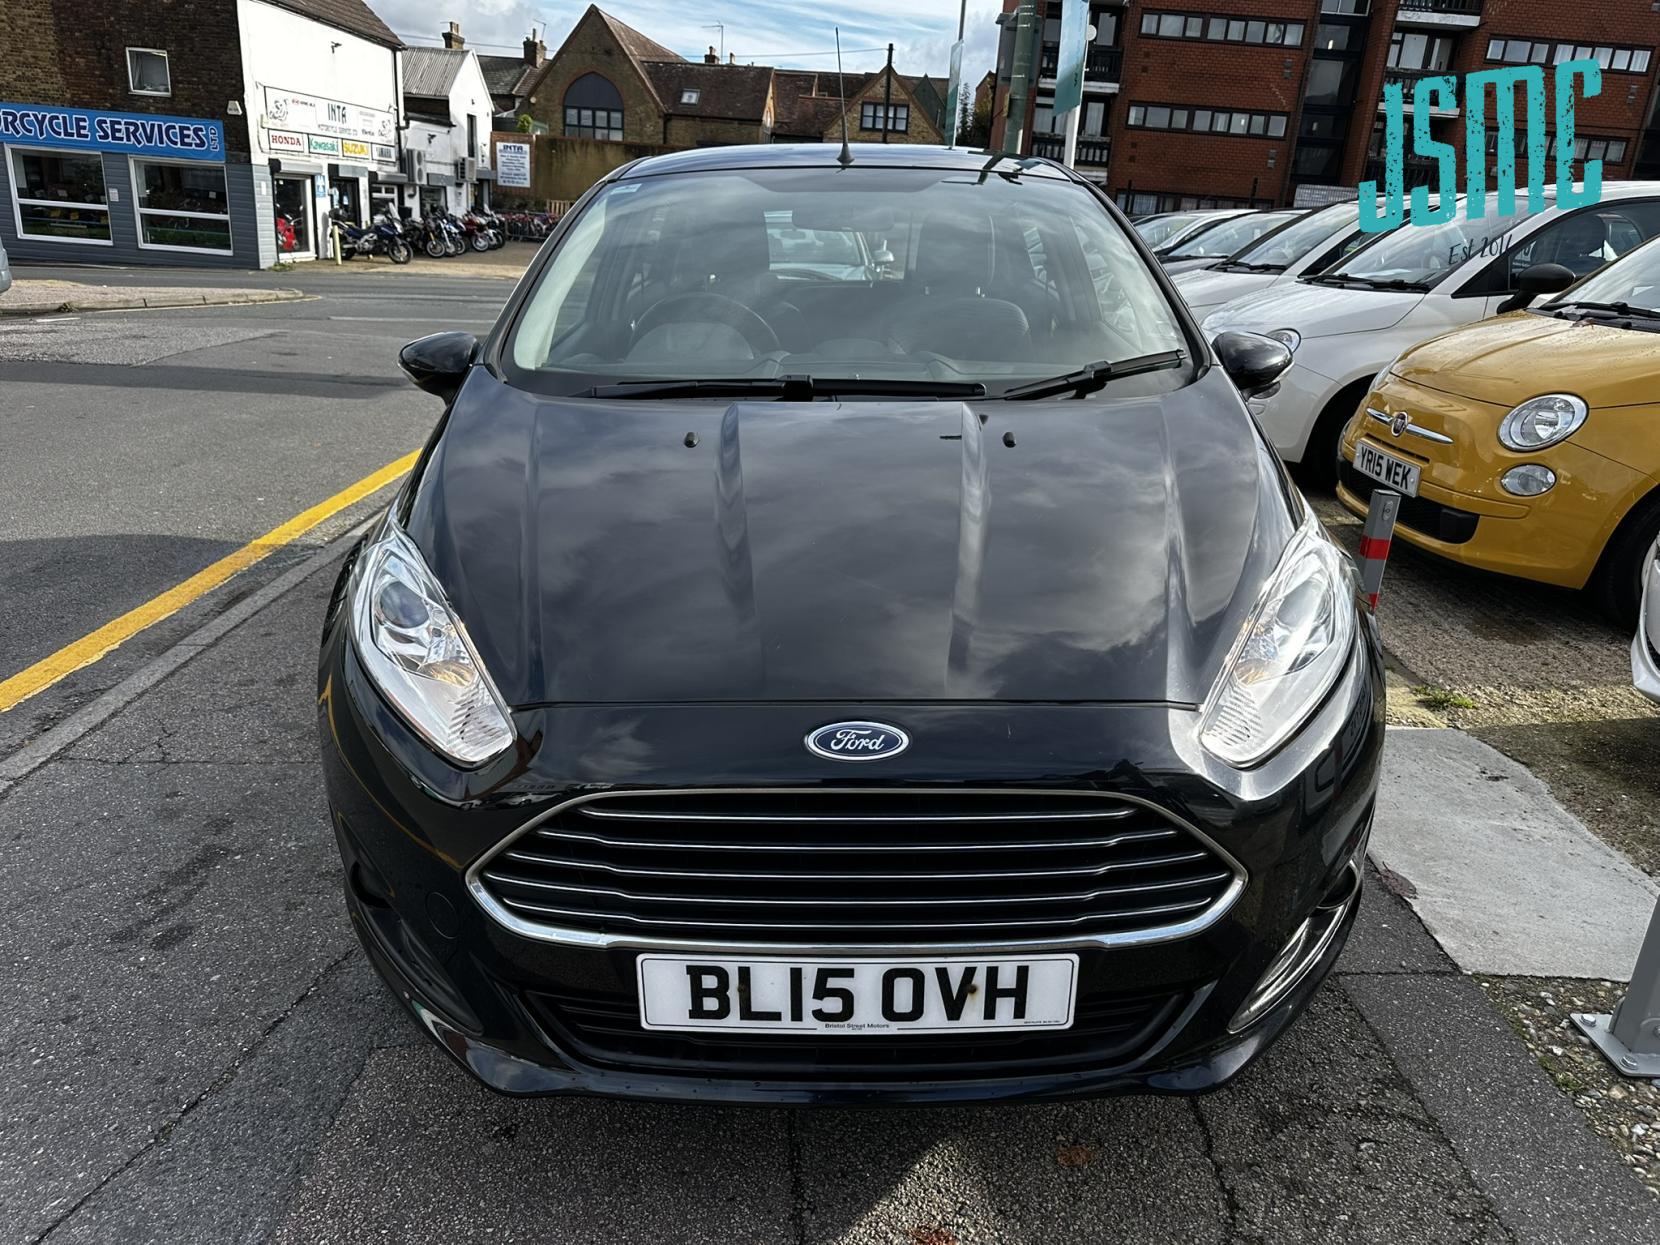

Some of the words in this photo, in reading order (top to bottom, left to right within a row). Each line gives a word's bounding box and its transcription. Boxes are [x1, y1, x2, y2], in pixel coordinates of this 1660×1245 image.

[327, 103, 347, 124] INTA
[0, 109, 89, 138] RCYCLE
[96, 117, 208, 150] SERVICES
[208, 126, 220, 151] LTD
[271, 134, 302, 147] HONDA
[310, 137, 339, 153] Kawasaki
[343, 141, 369, 155] SUZUKI
[1360, 446, 1384, 477] YR15
[1385, 459, 1411, 490] WEK
[830, 729, 886, 750] Ford
[686, 965, 855, 1023] BL15
[881, 965, 1030, 1023] OVH
